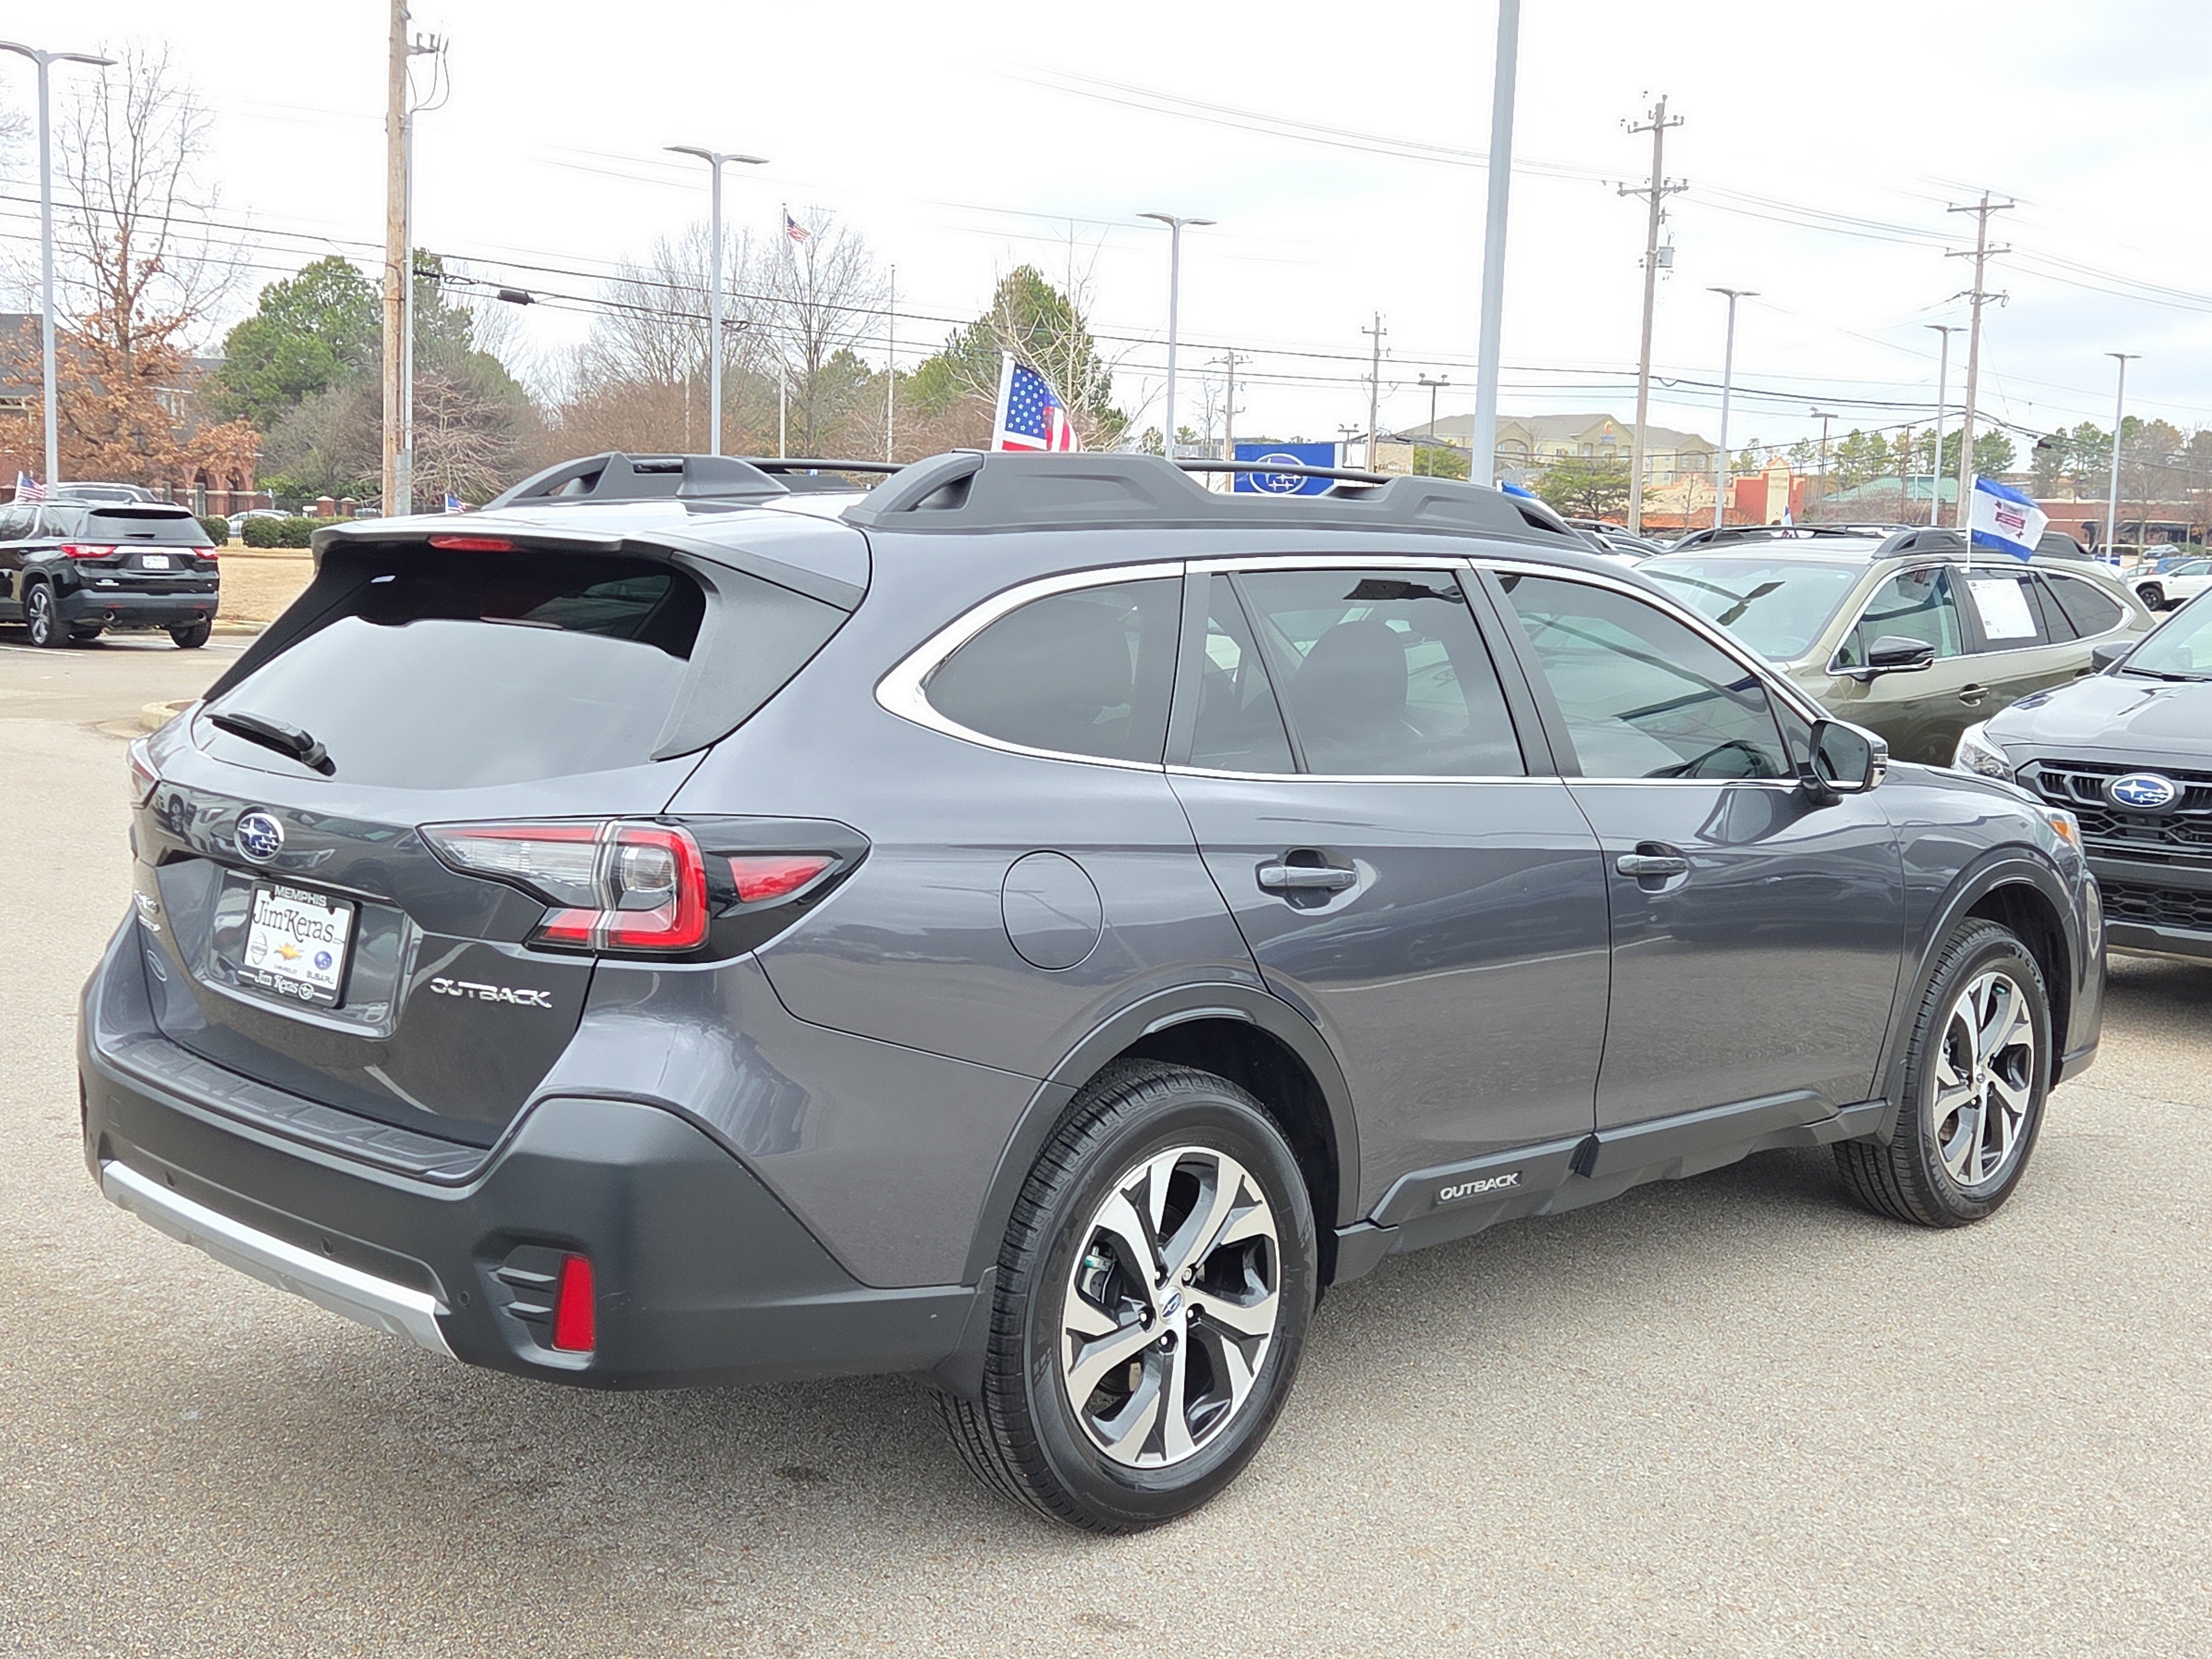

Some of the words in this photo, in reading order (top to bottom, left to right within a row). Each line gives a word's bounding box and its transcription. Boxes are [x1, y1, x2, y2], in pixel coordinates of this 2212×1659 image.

[274, 885, 327, 906] MEMPHIS
[430, 977, 552, 1008] OUTBACK
[1440, 1172, 1519, 1200] OUTBACK
